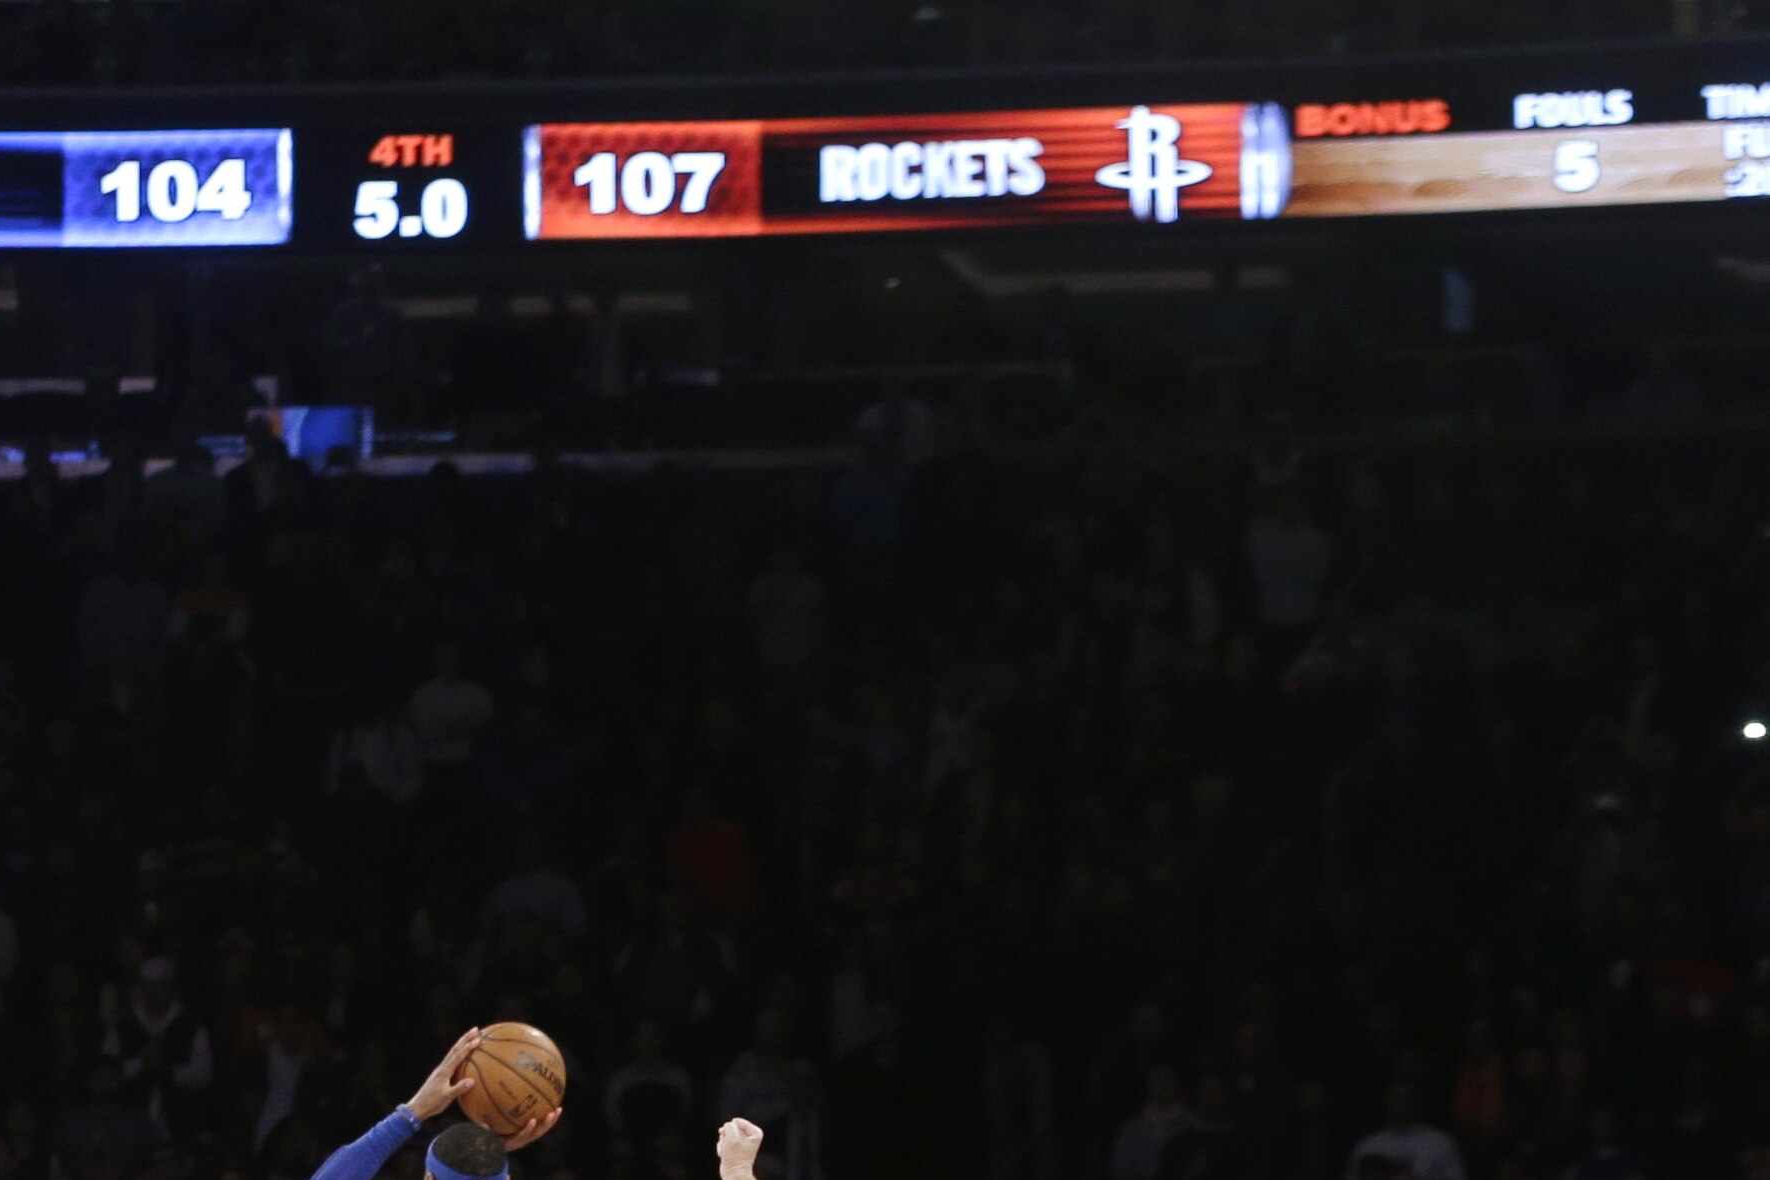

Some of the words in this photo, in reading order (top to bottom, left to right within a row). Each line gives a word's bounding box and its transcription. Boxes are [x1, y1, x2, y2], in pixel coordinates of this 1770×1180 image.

[1295, 100, 1451, 137] BONUS
[1513, 89, 1634, 129] FOULS
[369, 134, 453, 168] 4TH
[818, 136, 1047, 203] ROCKETS
[1553, 140, 1600, 193] 5
[99, 160, 252, 223] 104
[352, 177, 470, 240] 5.0
[573, 150, 726, 216] 107
